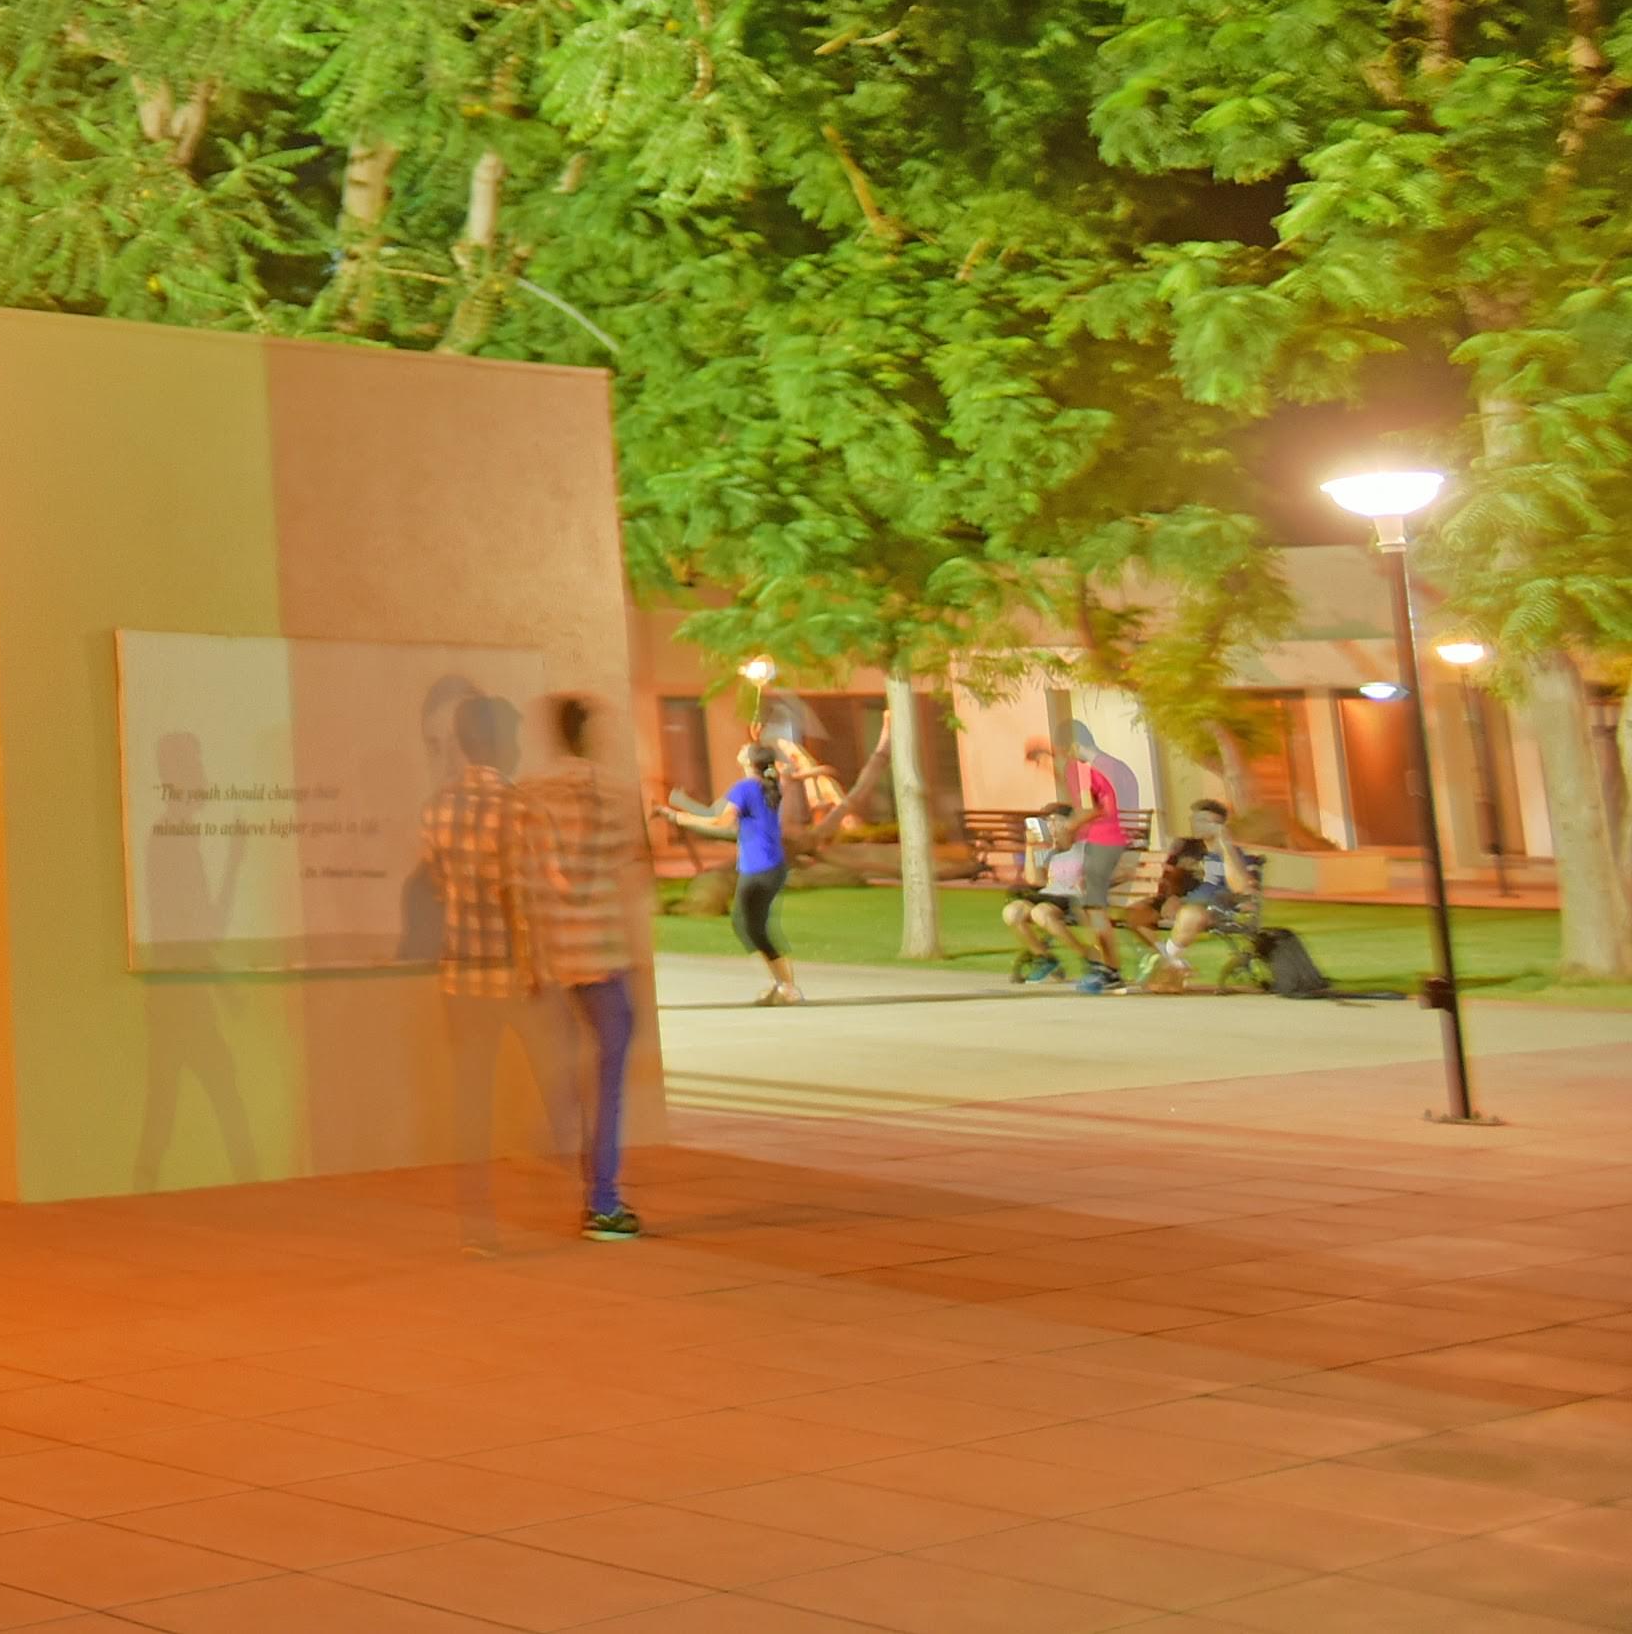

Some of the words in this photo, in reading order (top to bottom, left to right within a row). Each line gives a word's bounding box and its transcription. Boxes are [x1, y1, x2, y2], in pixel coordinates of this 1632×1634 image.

[224, 782, 265, 800] should
[204, 821, 218, 836] to
[220, 818, 265, 836] achieve
